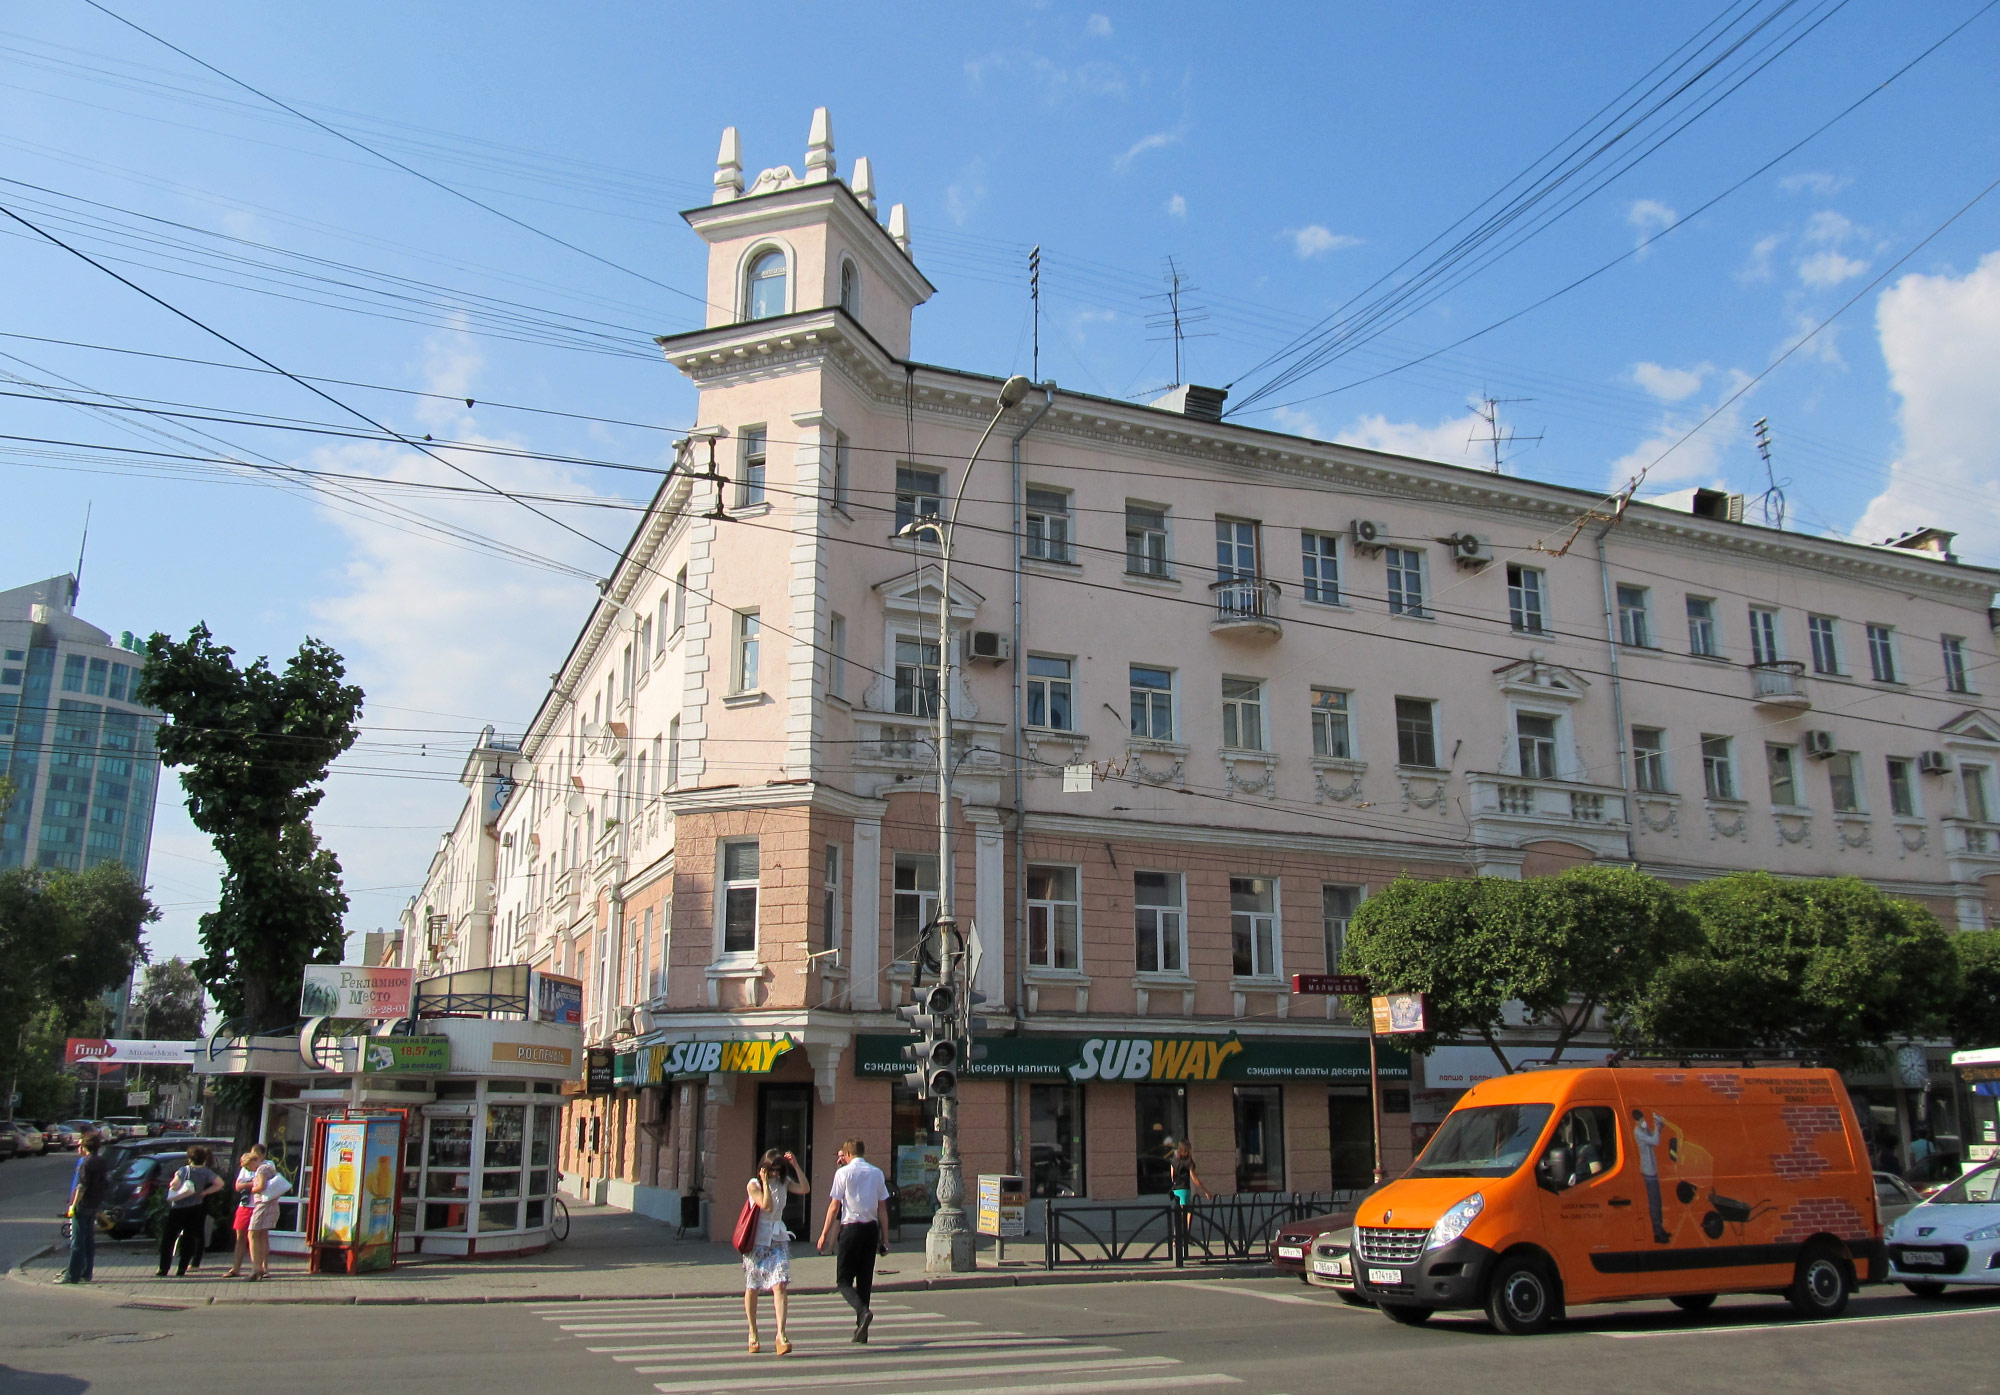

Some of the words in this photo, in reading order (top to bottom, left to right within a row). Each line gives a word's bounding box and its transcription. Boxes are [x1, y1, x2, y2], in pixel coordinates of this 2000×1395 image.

[340, 972, 408, 989] Рекламное
[1308, 984, 1360, 992] МАЛЫШЕВА
[350, 990, 391, 1005] Место
[517, 1047, 565, 1062] РОСПЕЧАТЬ
[663, 1039, 794, 1073] SUBWAY
[1068, 1038, 1243, 1082] SUBWAY
[592, 1067, 611, 1075] simple
[864, 1062, 919, 1072] сэндвичи
[1017, 1065, 1061, 1074] напитки
[1246, 1067, 1293, 1076] сэндвичи
[1294, 1067, 1329, 1076] салаты
[1331, 1067, 1370, 1077] десерты
[1374, 1067, 1408, 1076] апитки
